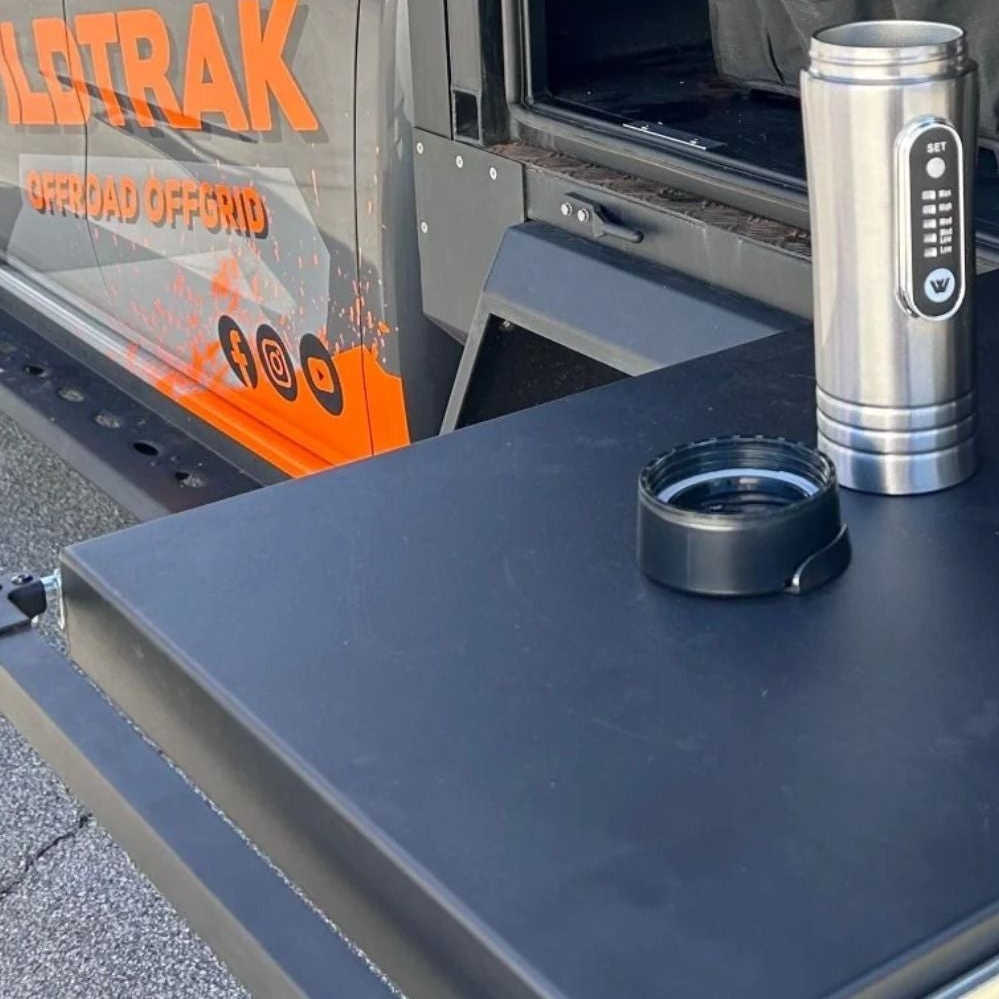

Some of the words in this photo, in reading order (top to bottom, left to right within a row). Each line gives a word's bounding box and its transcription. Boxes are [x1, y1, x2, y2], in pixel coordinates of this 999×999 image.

[926, 141, 947, 154] SET
[26, 169, 138, 220] OFFROAD
[144, 175, 266, 234] OFFGRID
